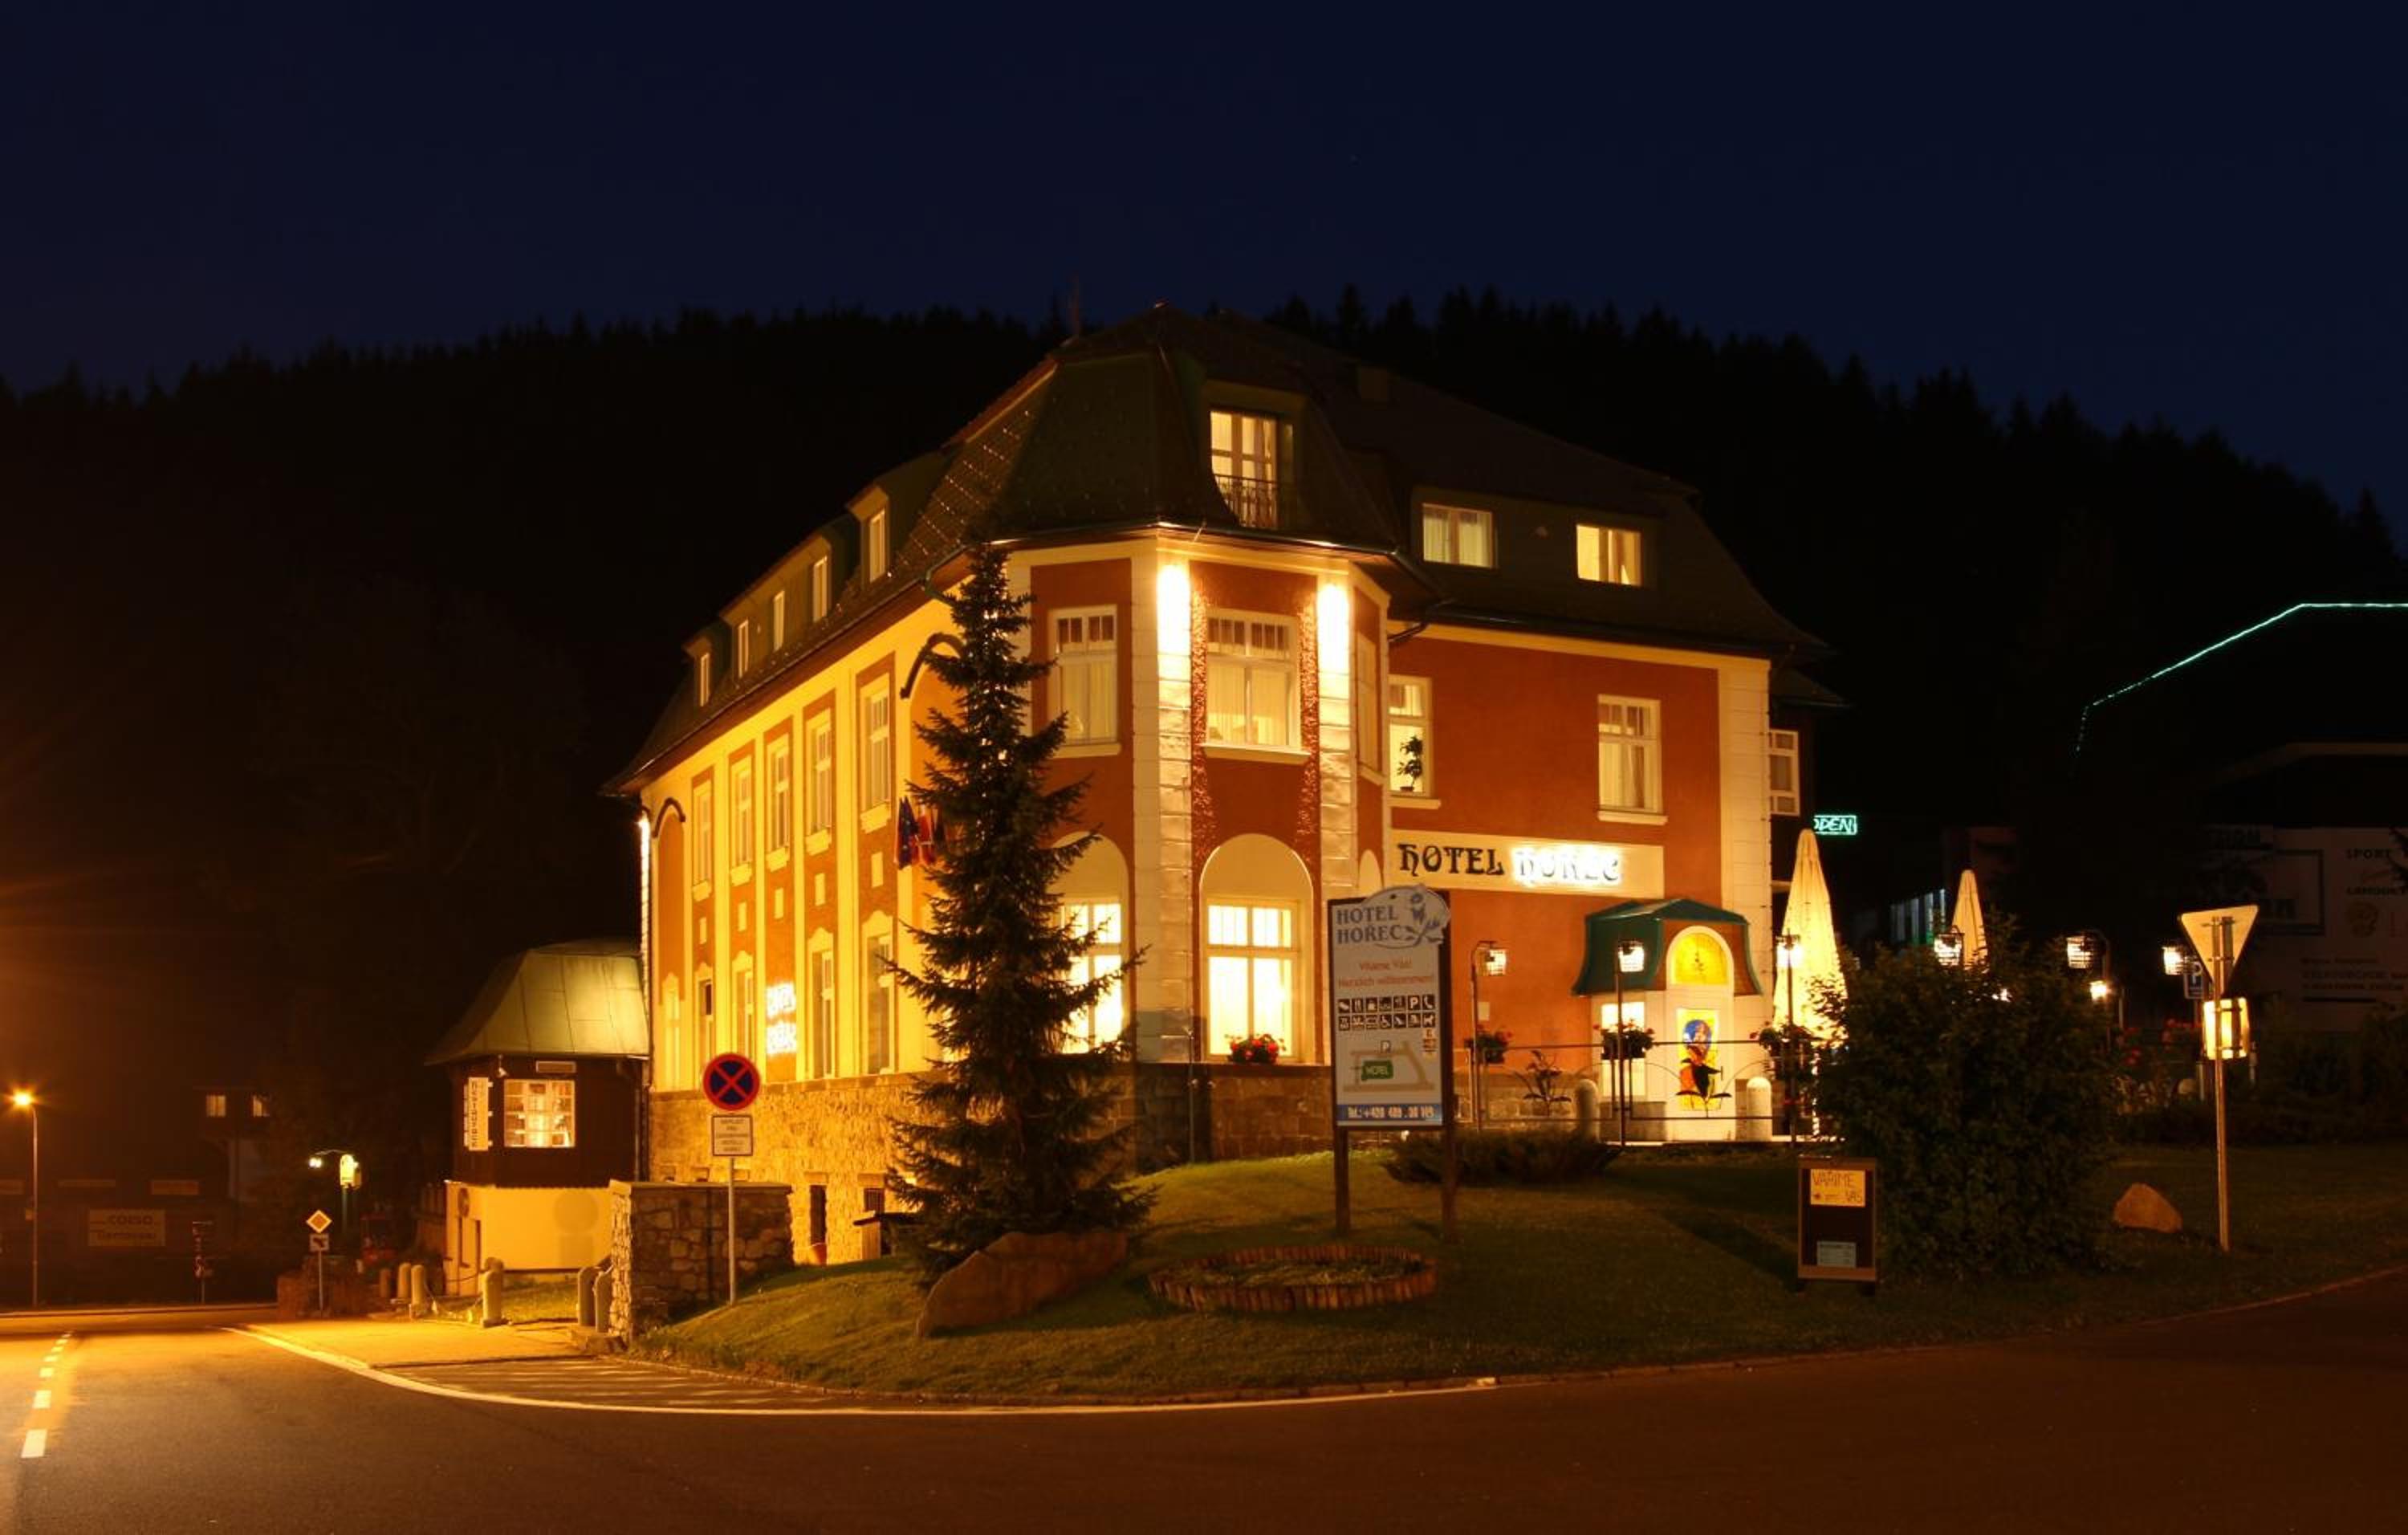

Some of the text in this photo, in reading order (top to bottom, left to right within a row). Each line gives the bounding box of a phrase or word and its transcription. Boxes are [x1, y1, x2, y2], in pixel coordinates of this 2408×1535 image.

[1397, 843, 1620, 882] HOTEL HOC
[1336, 905, 1399, 925] HOTEL
